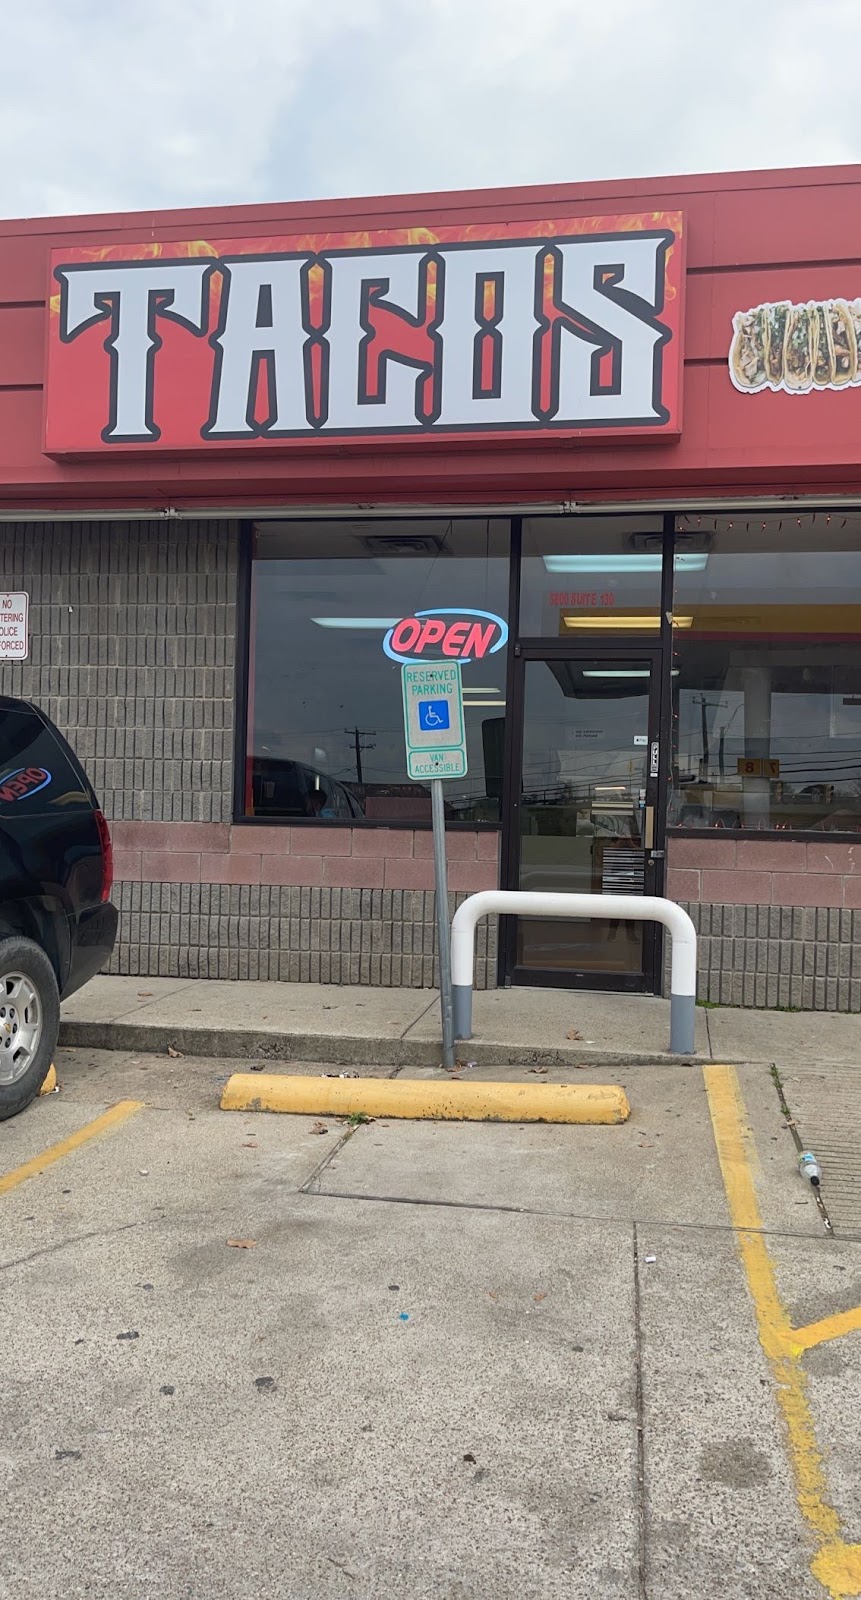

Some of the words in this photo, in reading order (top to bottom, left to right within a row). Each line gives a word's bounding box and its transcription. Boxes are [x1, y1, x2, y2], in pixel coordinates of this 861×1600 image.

[54, 229, 675, 443] TACOS
[2, 599, 12, 609] NO
[570, 592, 597, 606] SUITE
[391, 618, 496, 658] OPEN
[407, 669, 456, 682] RESERVED
[412, 683, 453, 695] PARKING
[430, 754, 444, 763] VAN
[415, 763, 460, 774] ACCESSIBLE
